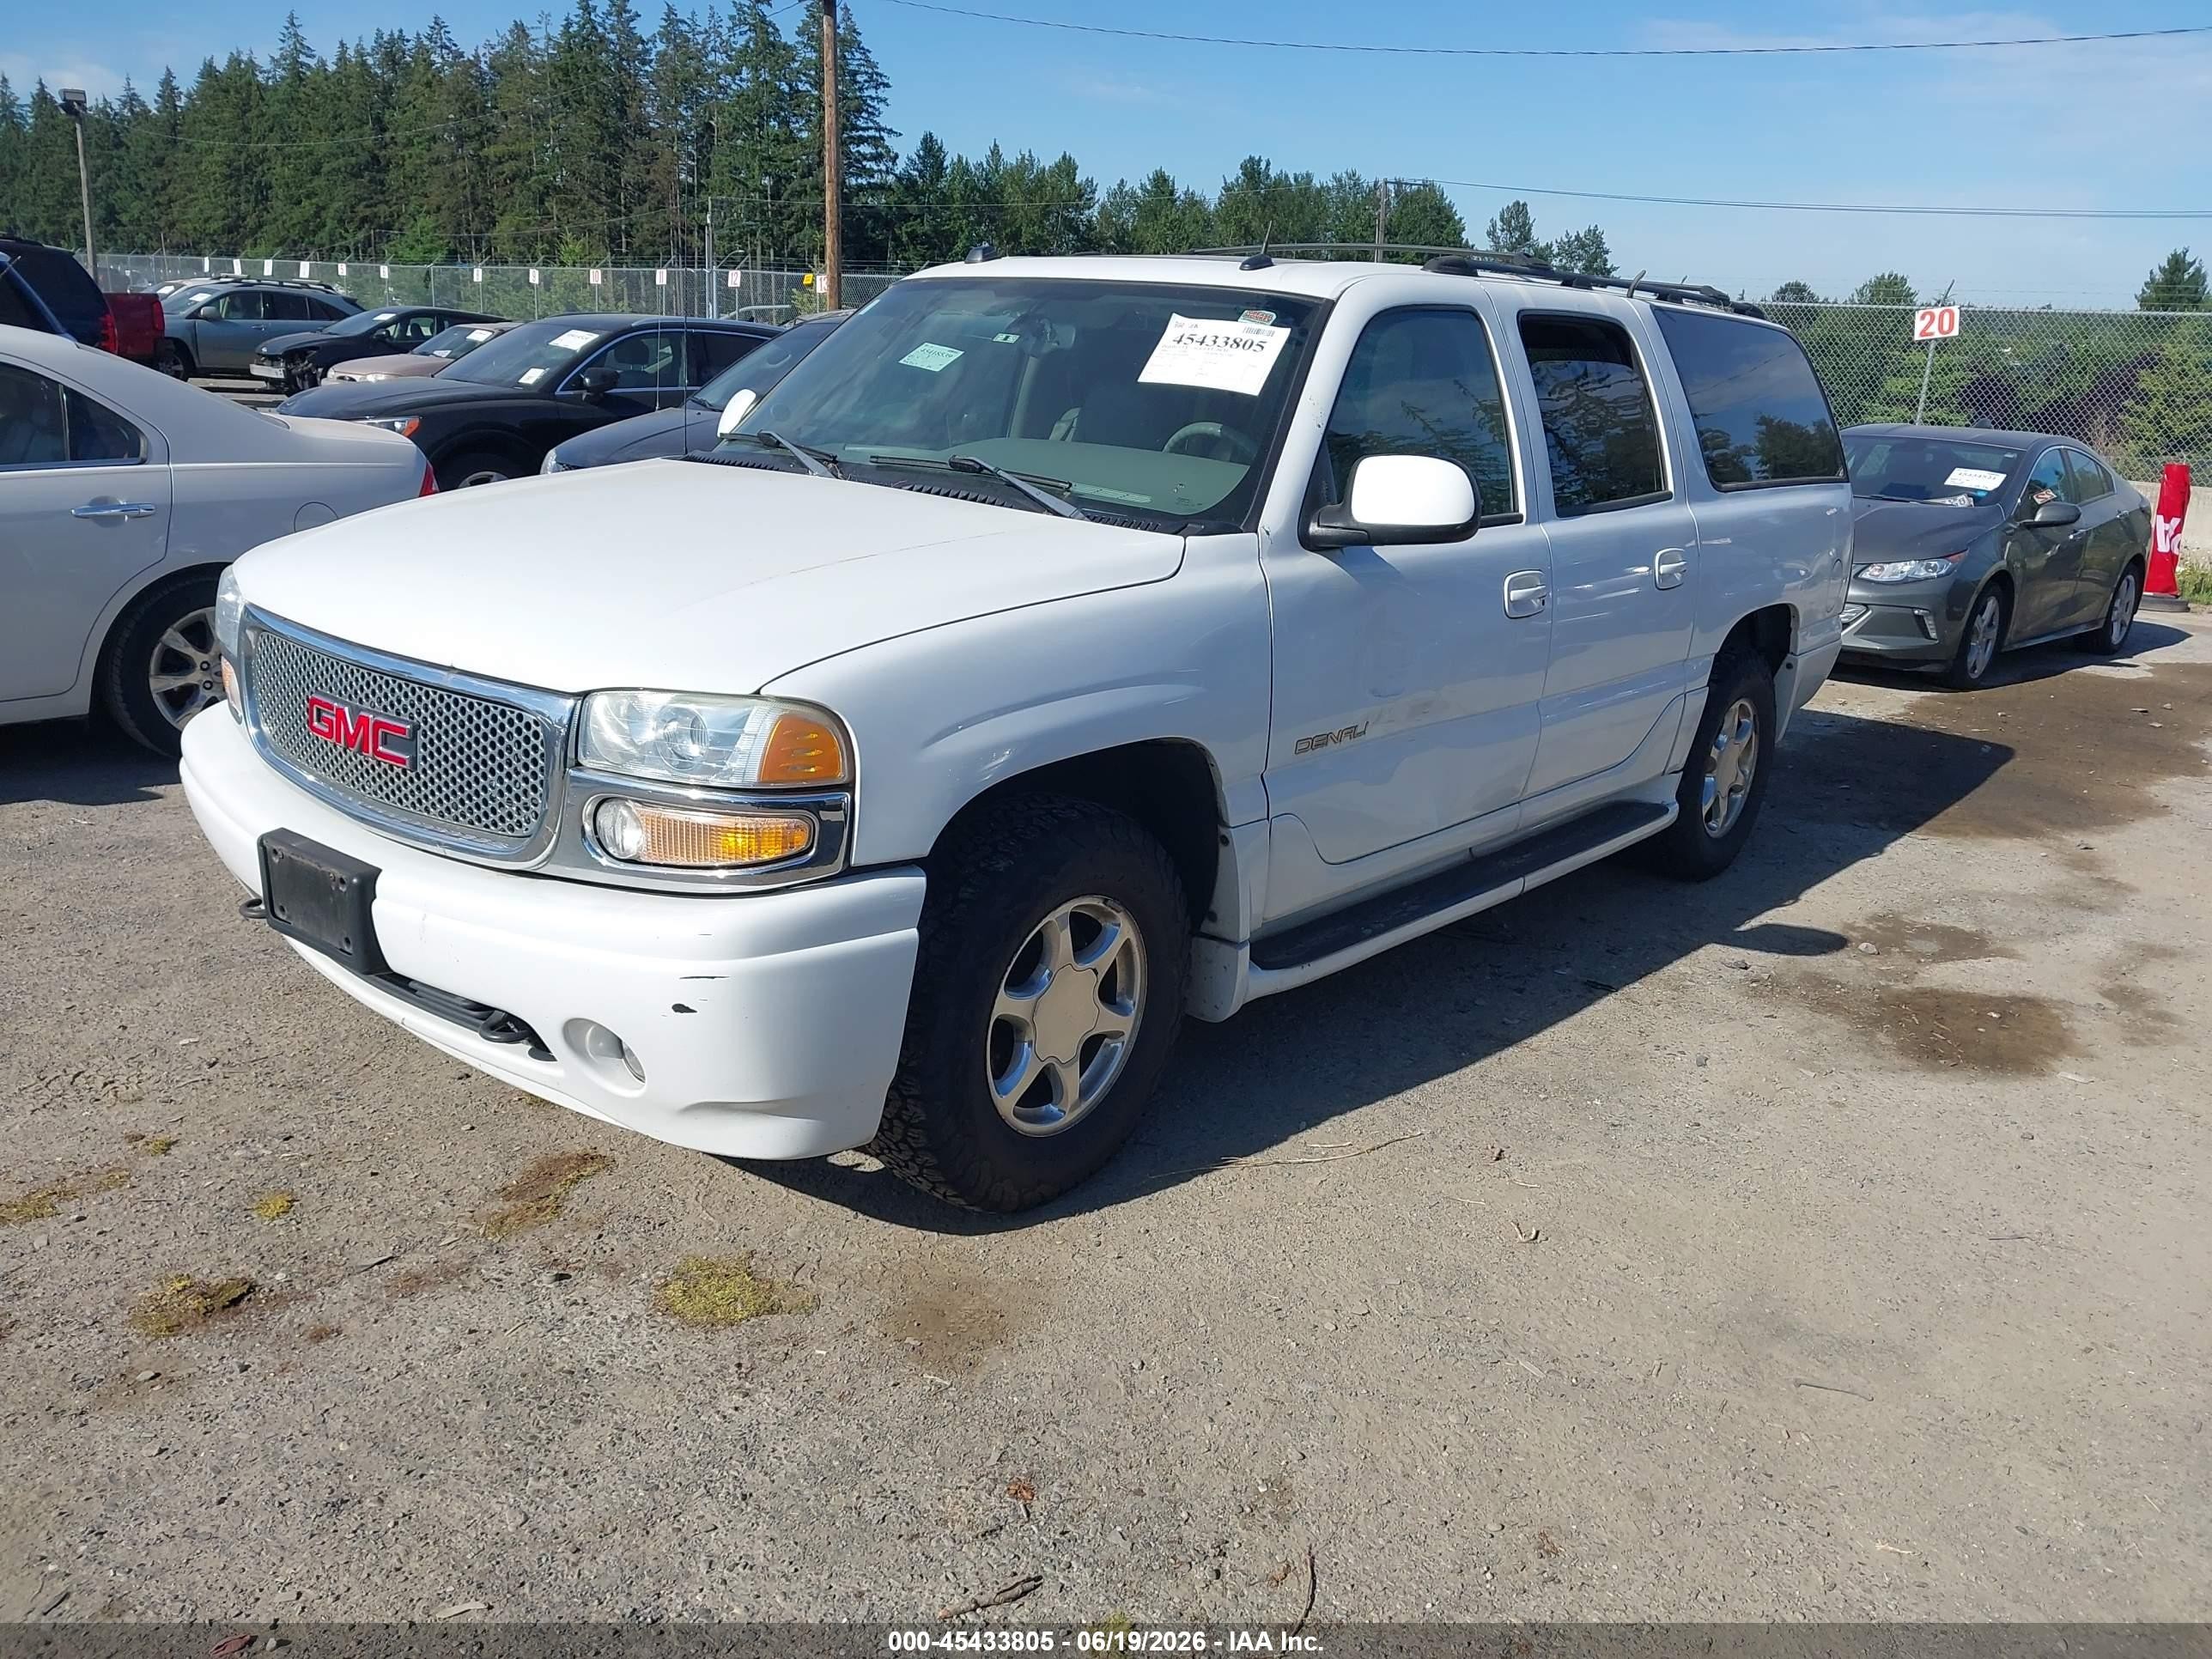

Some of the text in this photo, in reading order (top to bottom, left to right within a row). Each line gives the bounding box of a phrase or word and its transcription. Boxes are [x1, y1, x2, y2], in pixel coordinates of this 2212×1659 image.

[592, 270, 599, 283] 10
[731, 271, 738, 285] 12
[1919, 308, 1954, 337] 20
[1173, 333, 1267, 352] 45433805
[309, 695, 410, 768] GMC
[1294, 720, 1370, 755] DENALI
